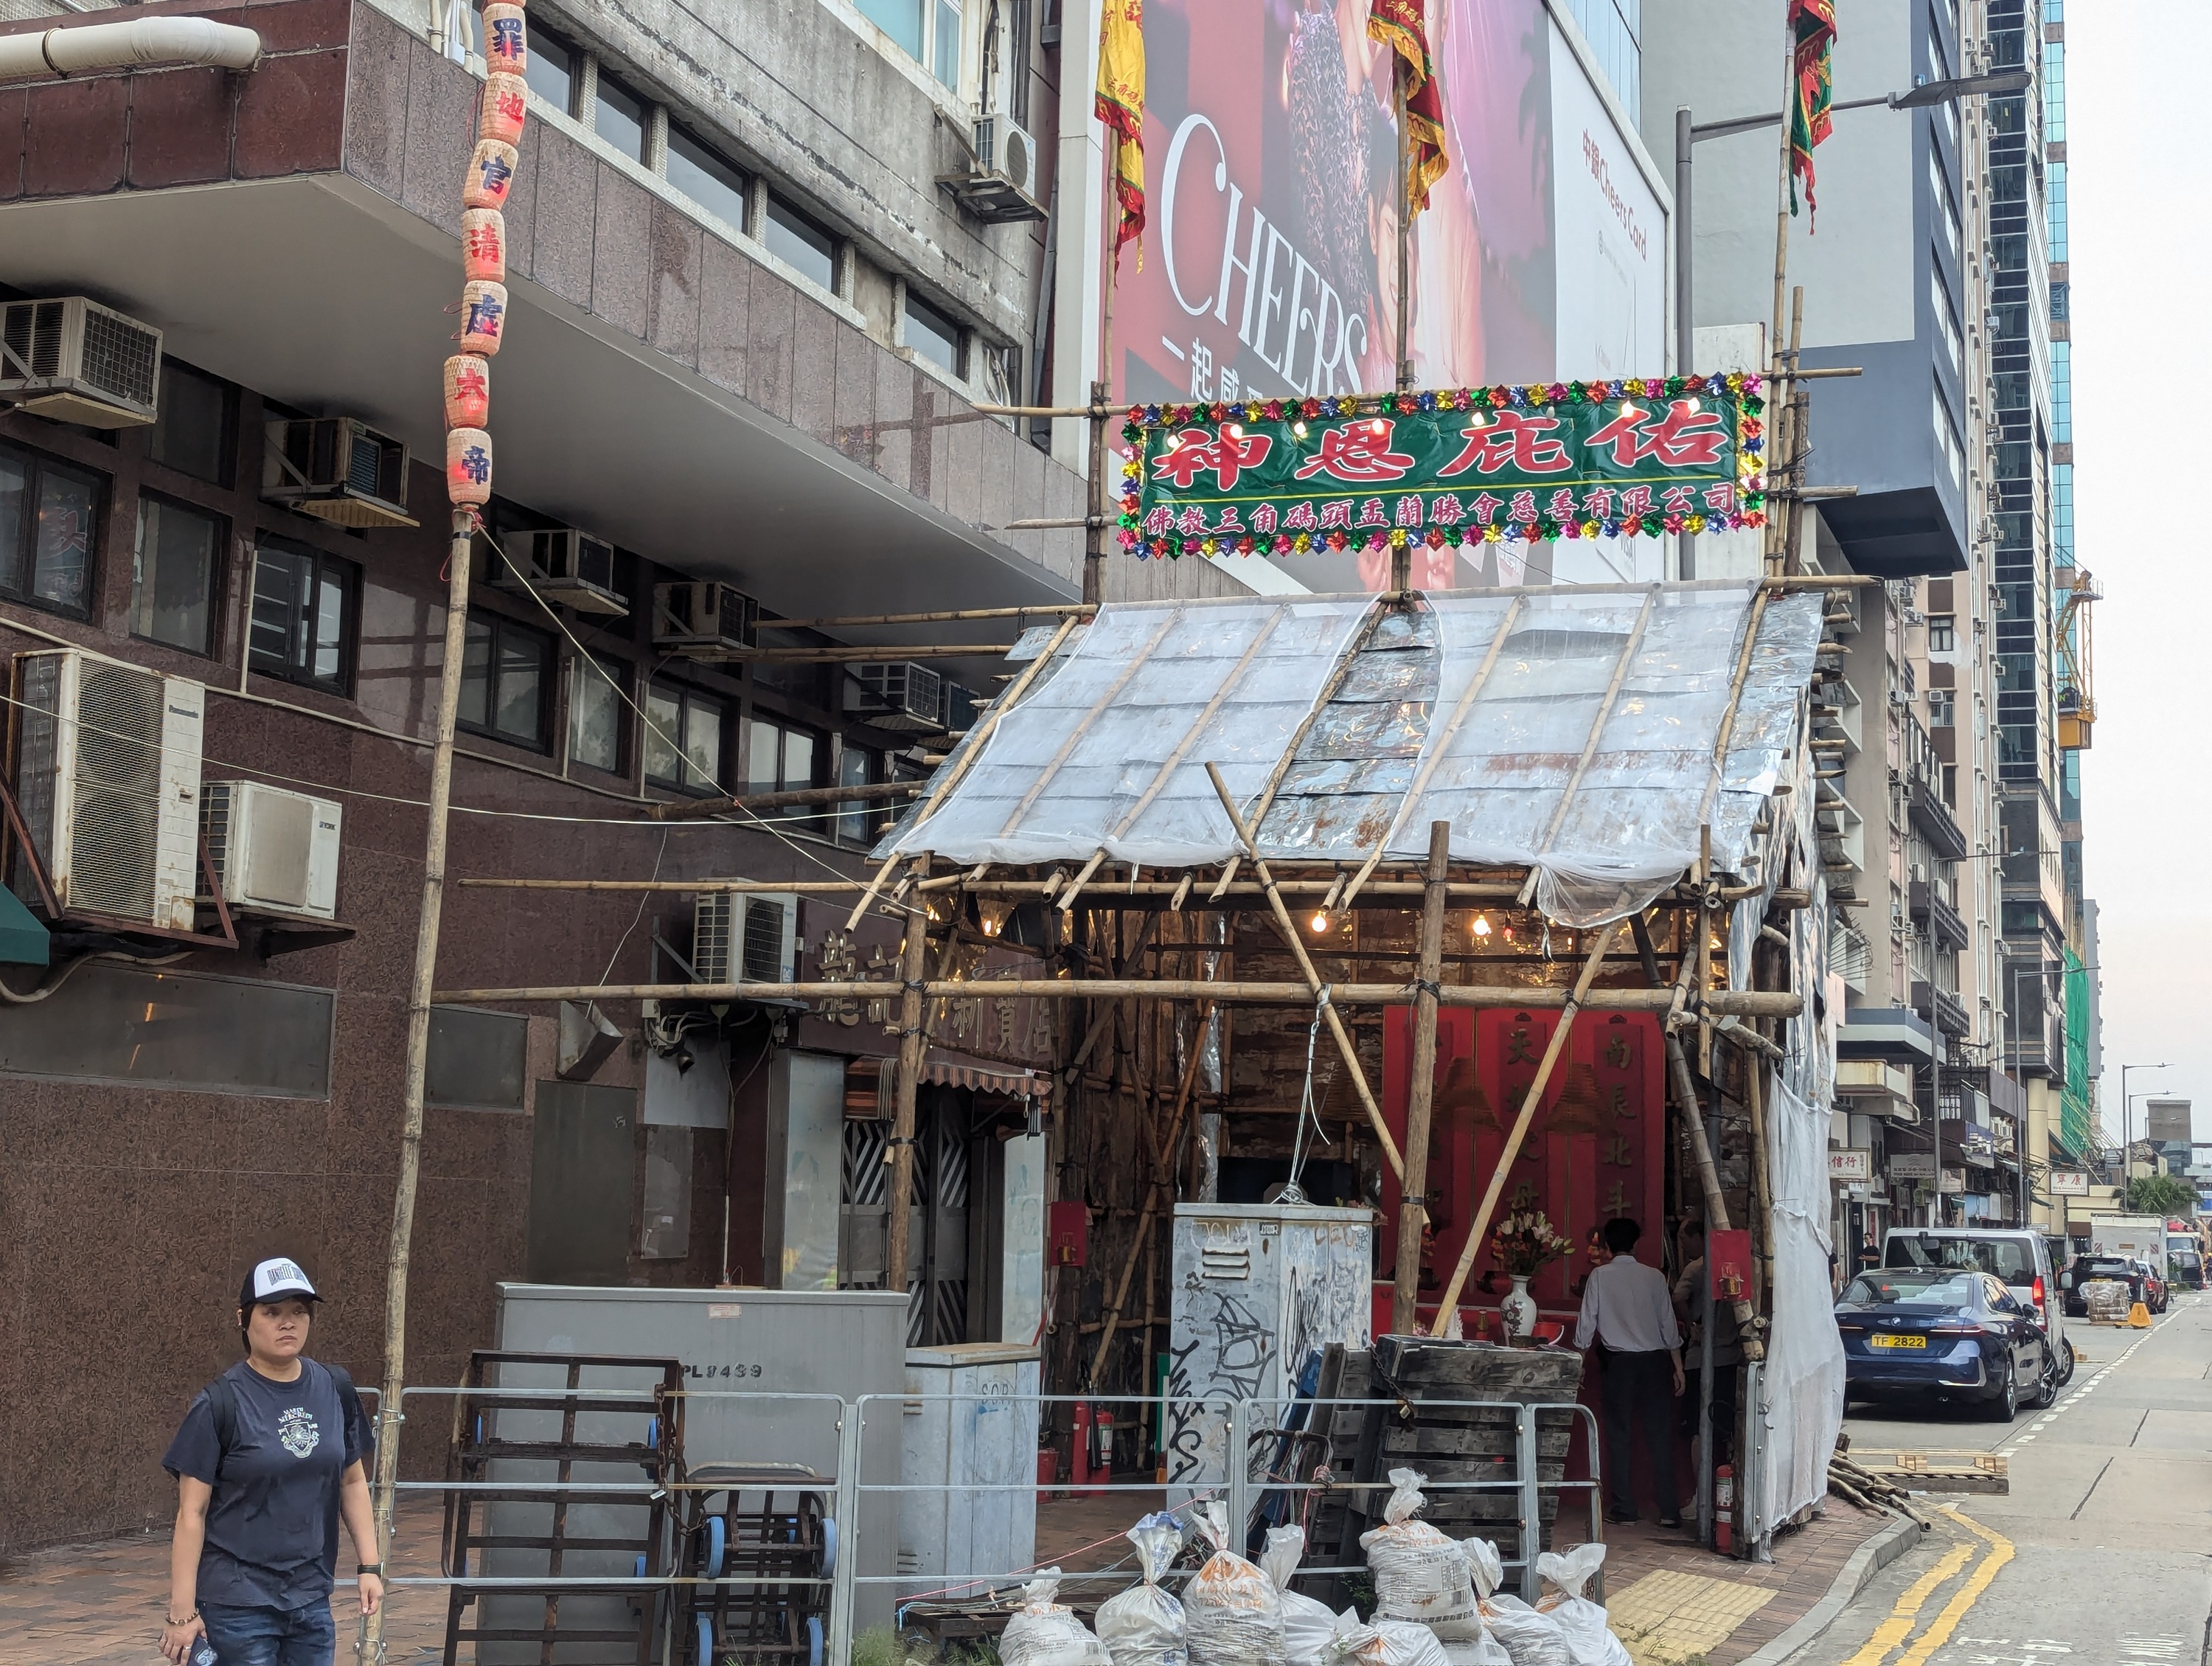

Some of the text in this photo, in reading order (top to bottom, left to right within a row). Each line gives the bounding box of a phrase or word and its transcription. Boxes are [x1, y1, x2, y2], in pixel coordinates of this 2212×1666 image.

[1161, 114, 1367, 396] CHEERS
[1151, 400, 1729, 492] 神恩庇佑
[1143, 482, 1737, 537] 佛教三角碼頭盂蘭勝會慈善有限公司
[1874, 1336, 1924, 1347] TF 2822
